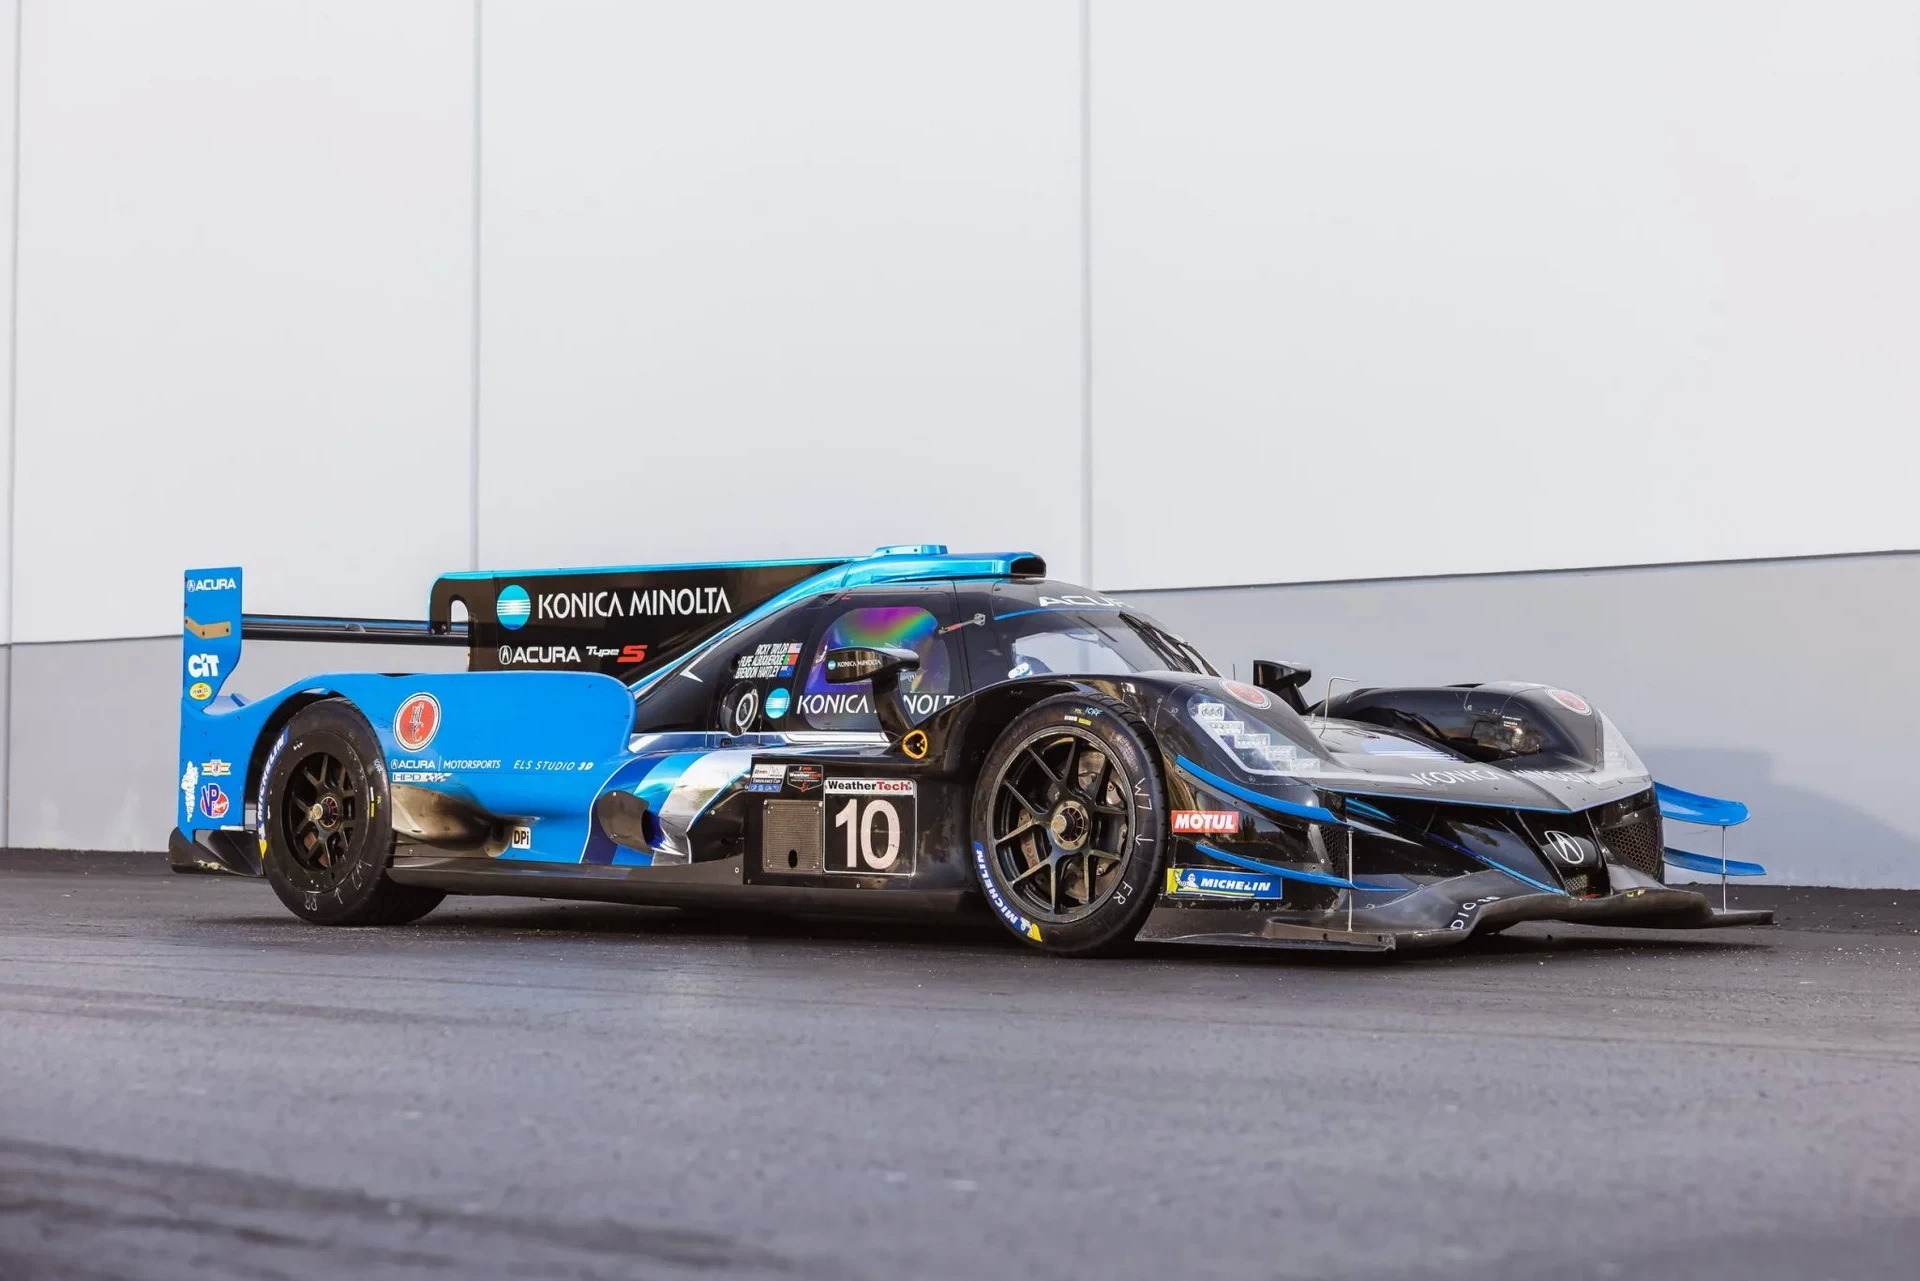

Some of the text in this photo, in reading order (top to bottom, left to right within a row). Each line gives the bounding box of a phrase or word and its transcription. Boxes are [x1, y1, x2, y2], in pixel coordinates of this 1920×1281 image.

[195, 578, 237, 591] ACURA
[538, 587, 732, 619] KONICA MINOLTA
[512, 645, 648, 663] ACURA Type S
[837, 659, 882, 668] KONICA MINOLTA
[796, 694, 869, 714] KONICA
[398, 760, 501, 770] ACURA MOTORSPORTS
[513, 760, 594, 770] ELS STUDIO 3D
[257, 734, 284, 821] MICHELIN
[201, 784, 220, 817] VP
[1174, 813, 1235, 830] MOTUL
[513, 830, 529, 845] DPi
[835, 798, 901, 870] 10
[976, 850, 1019, 924] MICHELIN
[1200, 878, 1271, 891] MICHELIN
